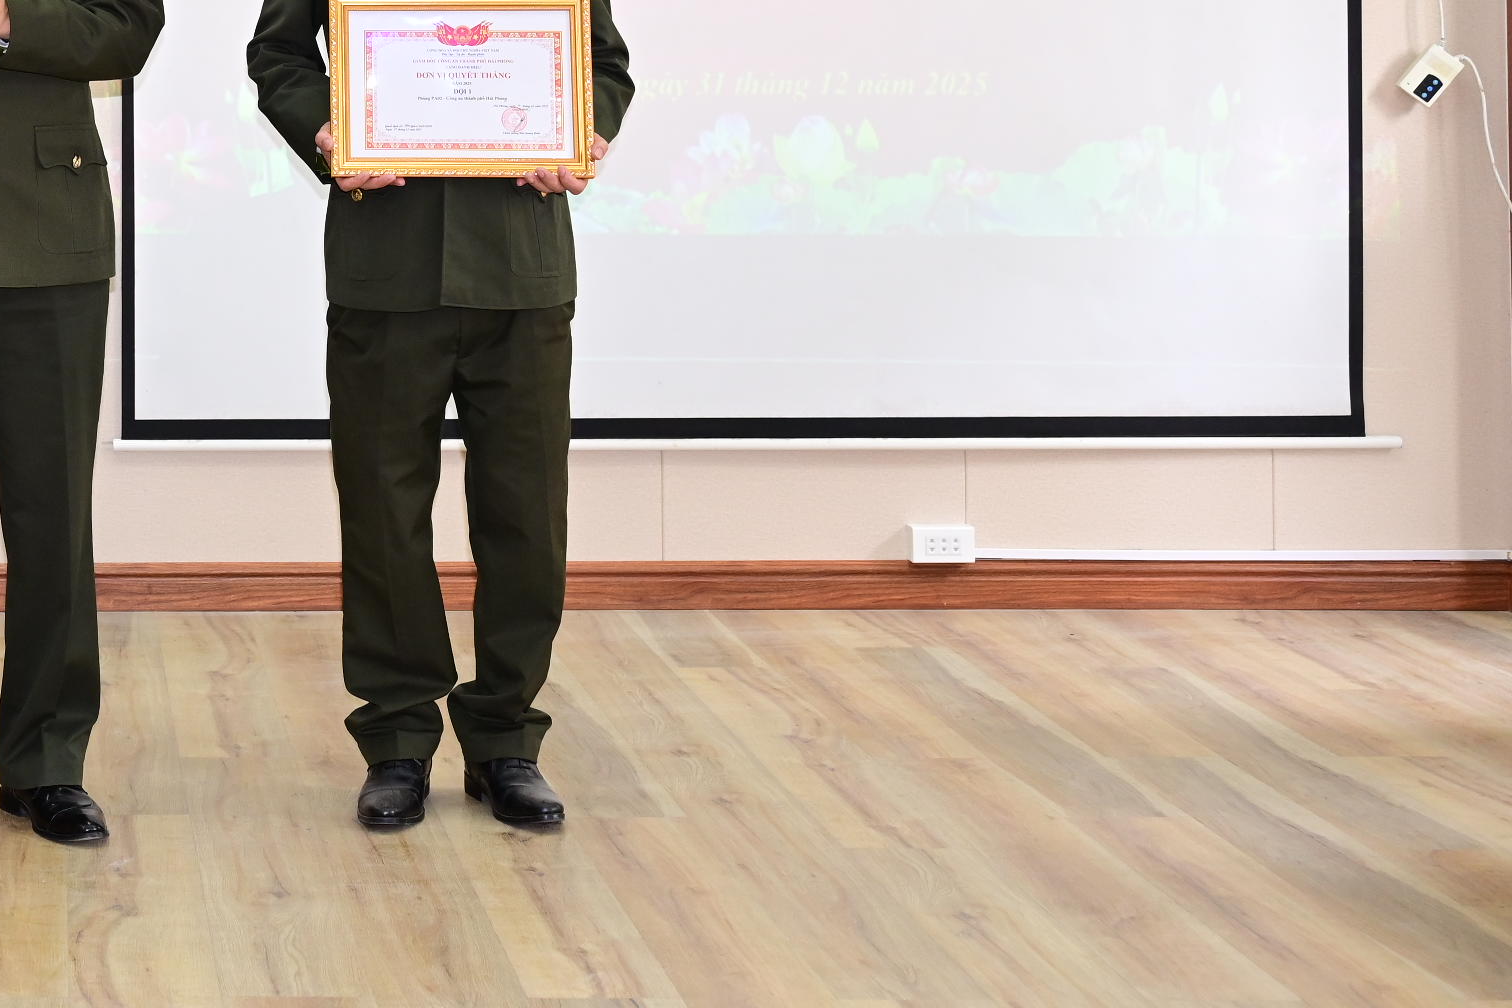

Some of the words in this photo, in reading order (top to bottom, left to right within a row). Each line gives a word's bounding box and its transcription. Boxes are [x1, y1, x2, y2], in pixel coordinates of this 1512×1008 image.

[636, 71, 688, 102] gày
[734, 71, 808, 102] tháng
[819, 71, 849, 96] 12
[923, 70, 992, 96] 2025
